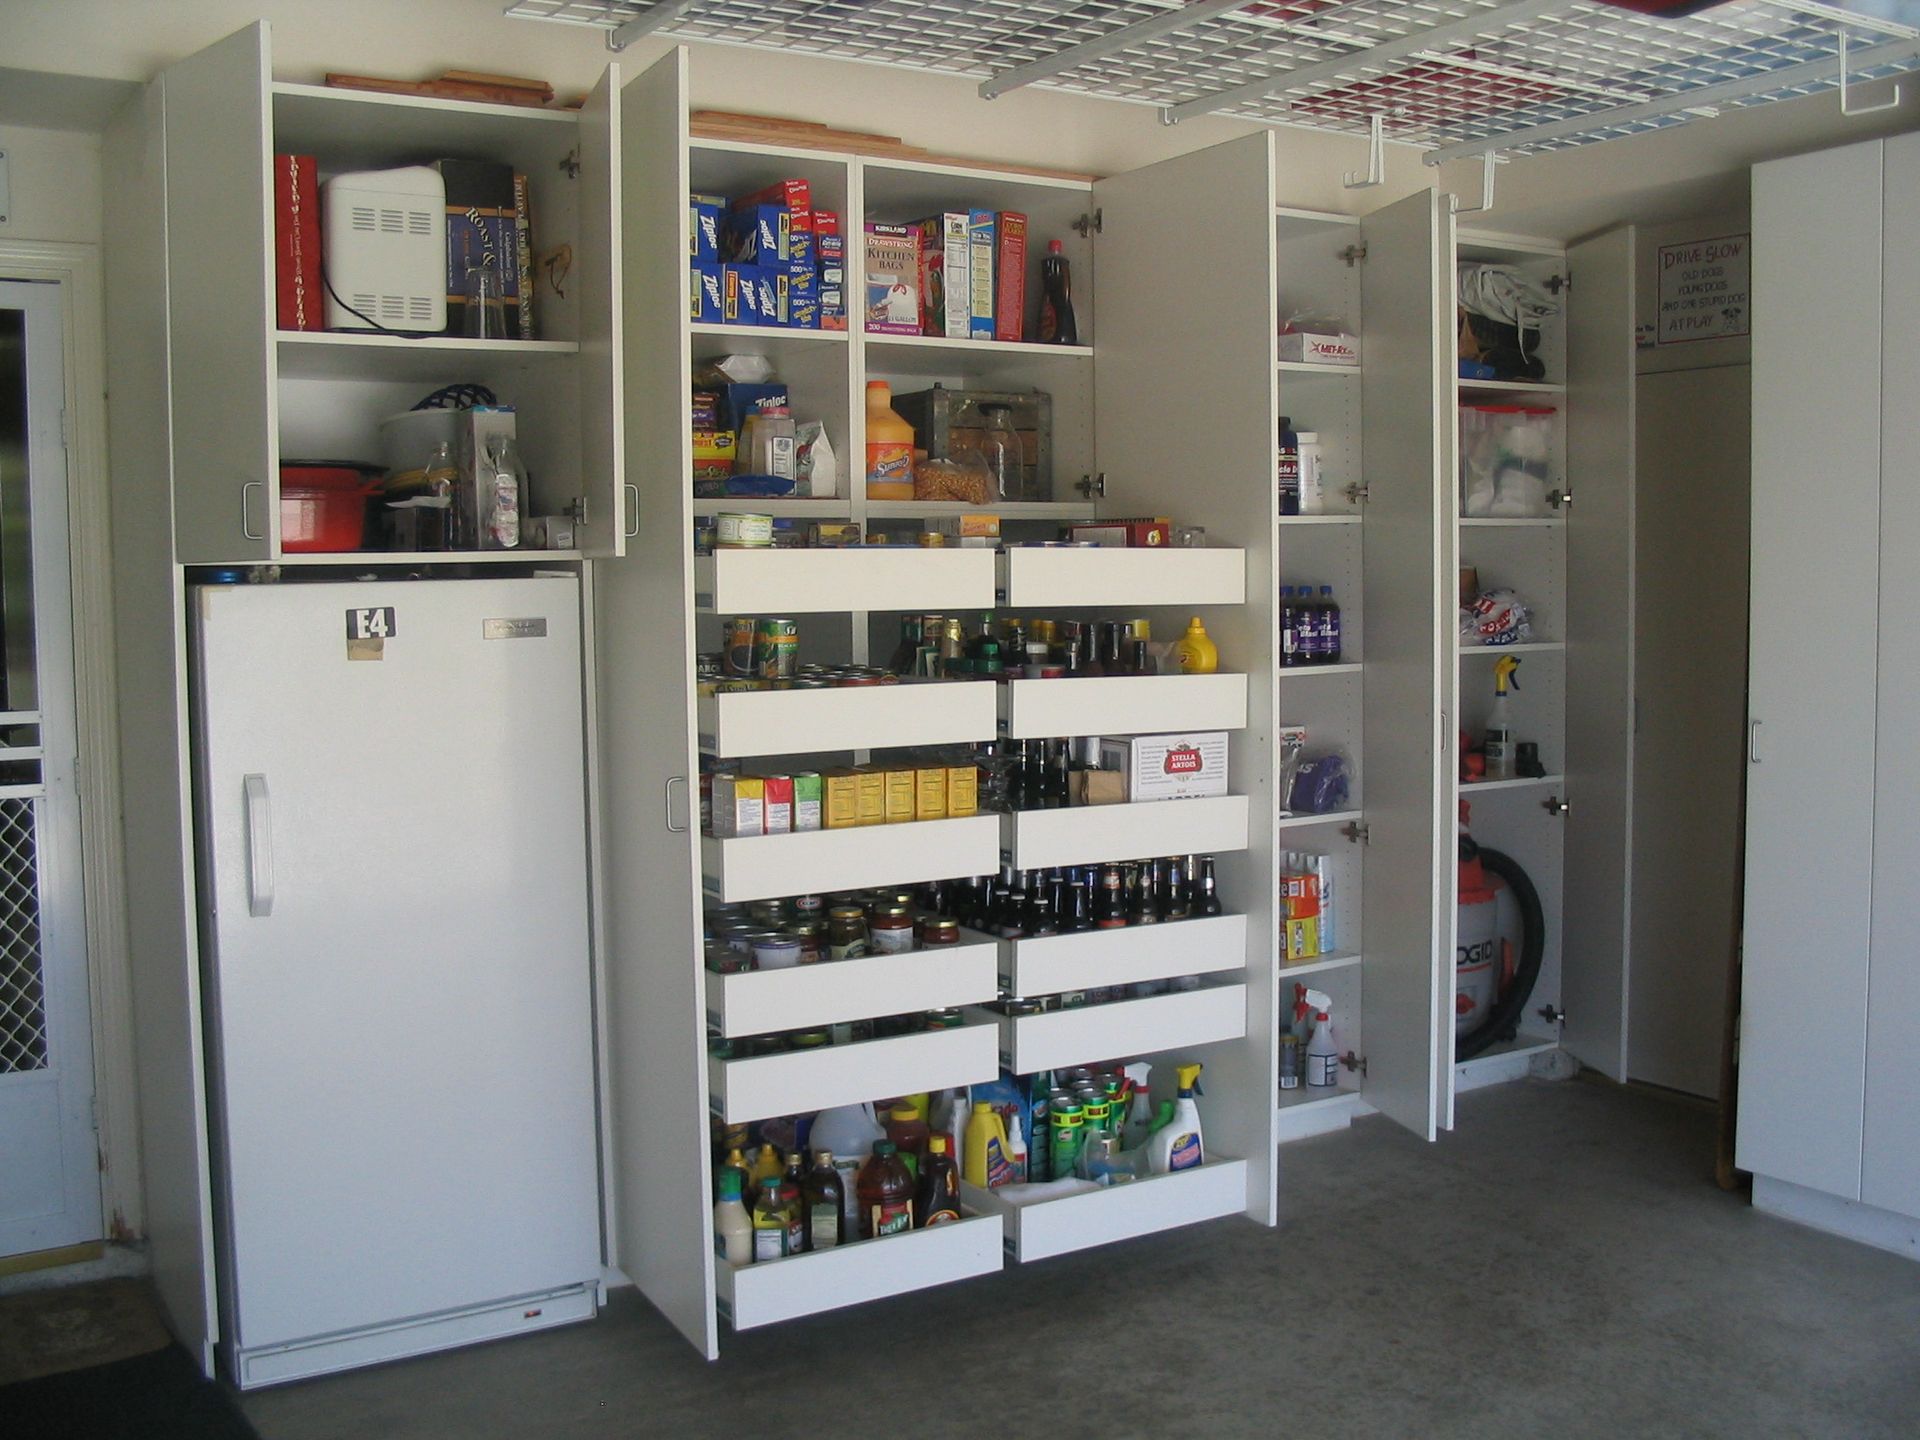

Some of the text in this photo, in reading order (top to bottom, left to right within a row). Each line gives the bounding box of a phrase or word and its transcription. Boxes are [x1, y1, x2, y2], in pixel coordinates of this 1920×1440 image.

[465, 207, 494, 249] ROAST
[699, 215, 718, 249] Ziploc
[759, 219, 777, 251] Ziploc
[875, 225, 907, 234] KIRKLAND
[867, 247, 915, 261] KITCHEN
[868, 238, 914, 249] DRAWSTRING
[1664, 243, 1742, 270] DRIVE SLOW
[878, 260, 904, 270] BAGS
[702, 273, 721, 308] Ziploc
[740, 279, 757, 311] Ziploc
[758, 287, 776, 317] Ziploc
[1669, 317, 1685, 331] AT
[1686, 314, 1713, 329] PLAY
[356, 608, 388, 639] E4
[1171, 761, 1196, 769] ARTOIS
